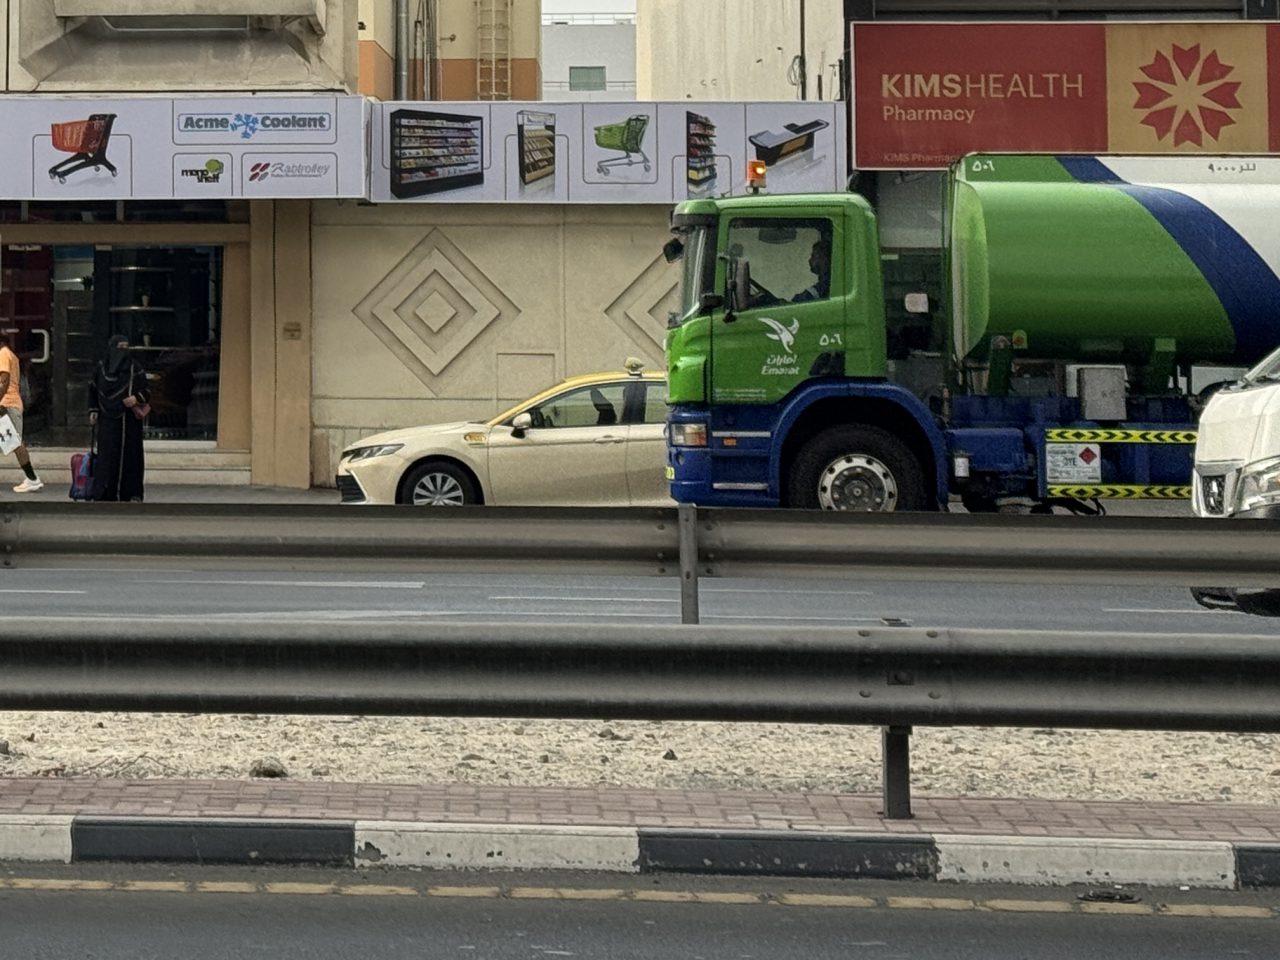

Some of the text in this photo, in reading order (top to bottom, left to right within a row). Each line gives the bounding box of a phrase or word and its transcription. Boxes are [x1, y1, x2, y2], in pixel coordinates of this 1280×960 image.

[881, 73, 1084, 99] KIMSHEALTH
[183, 115, 327, 129] Acme Coolant
[882, 106, 976, 123] Pharmacy
[761, 365, 801, 376] Emarat
